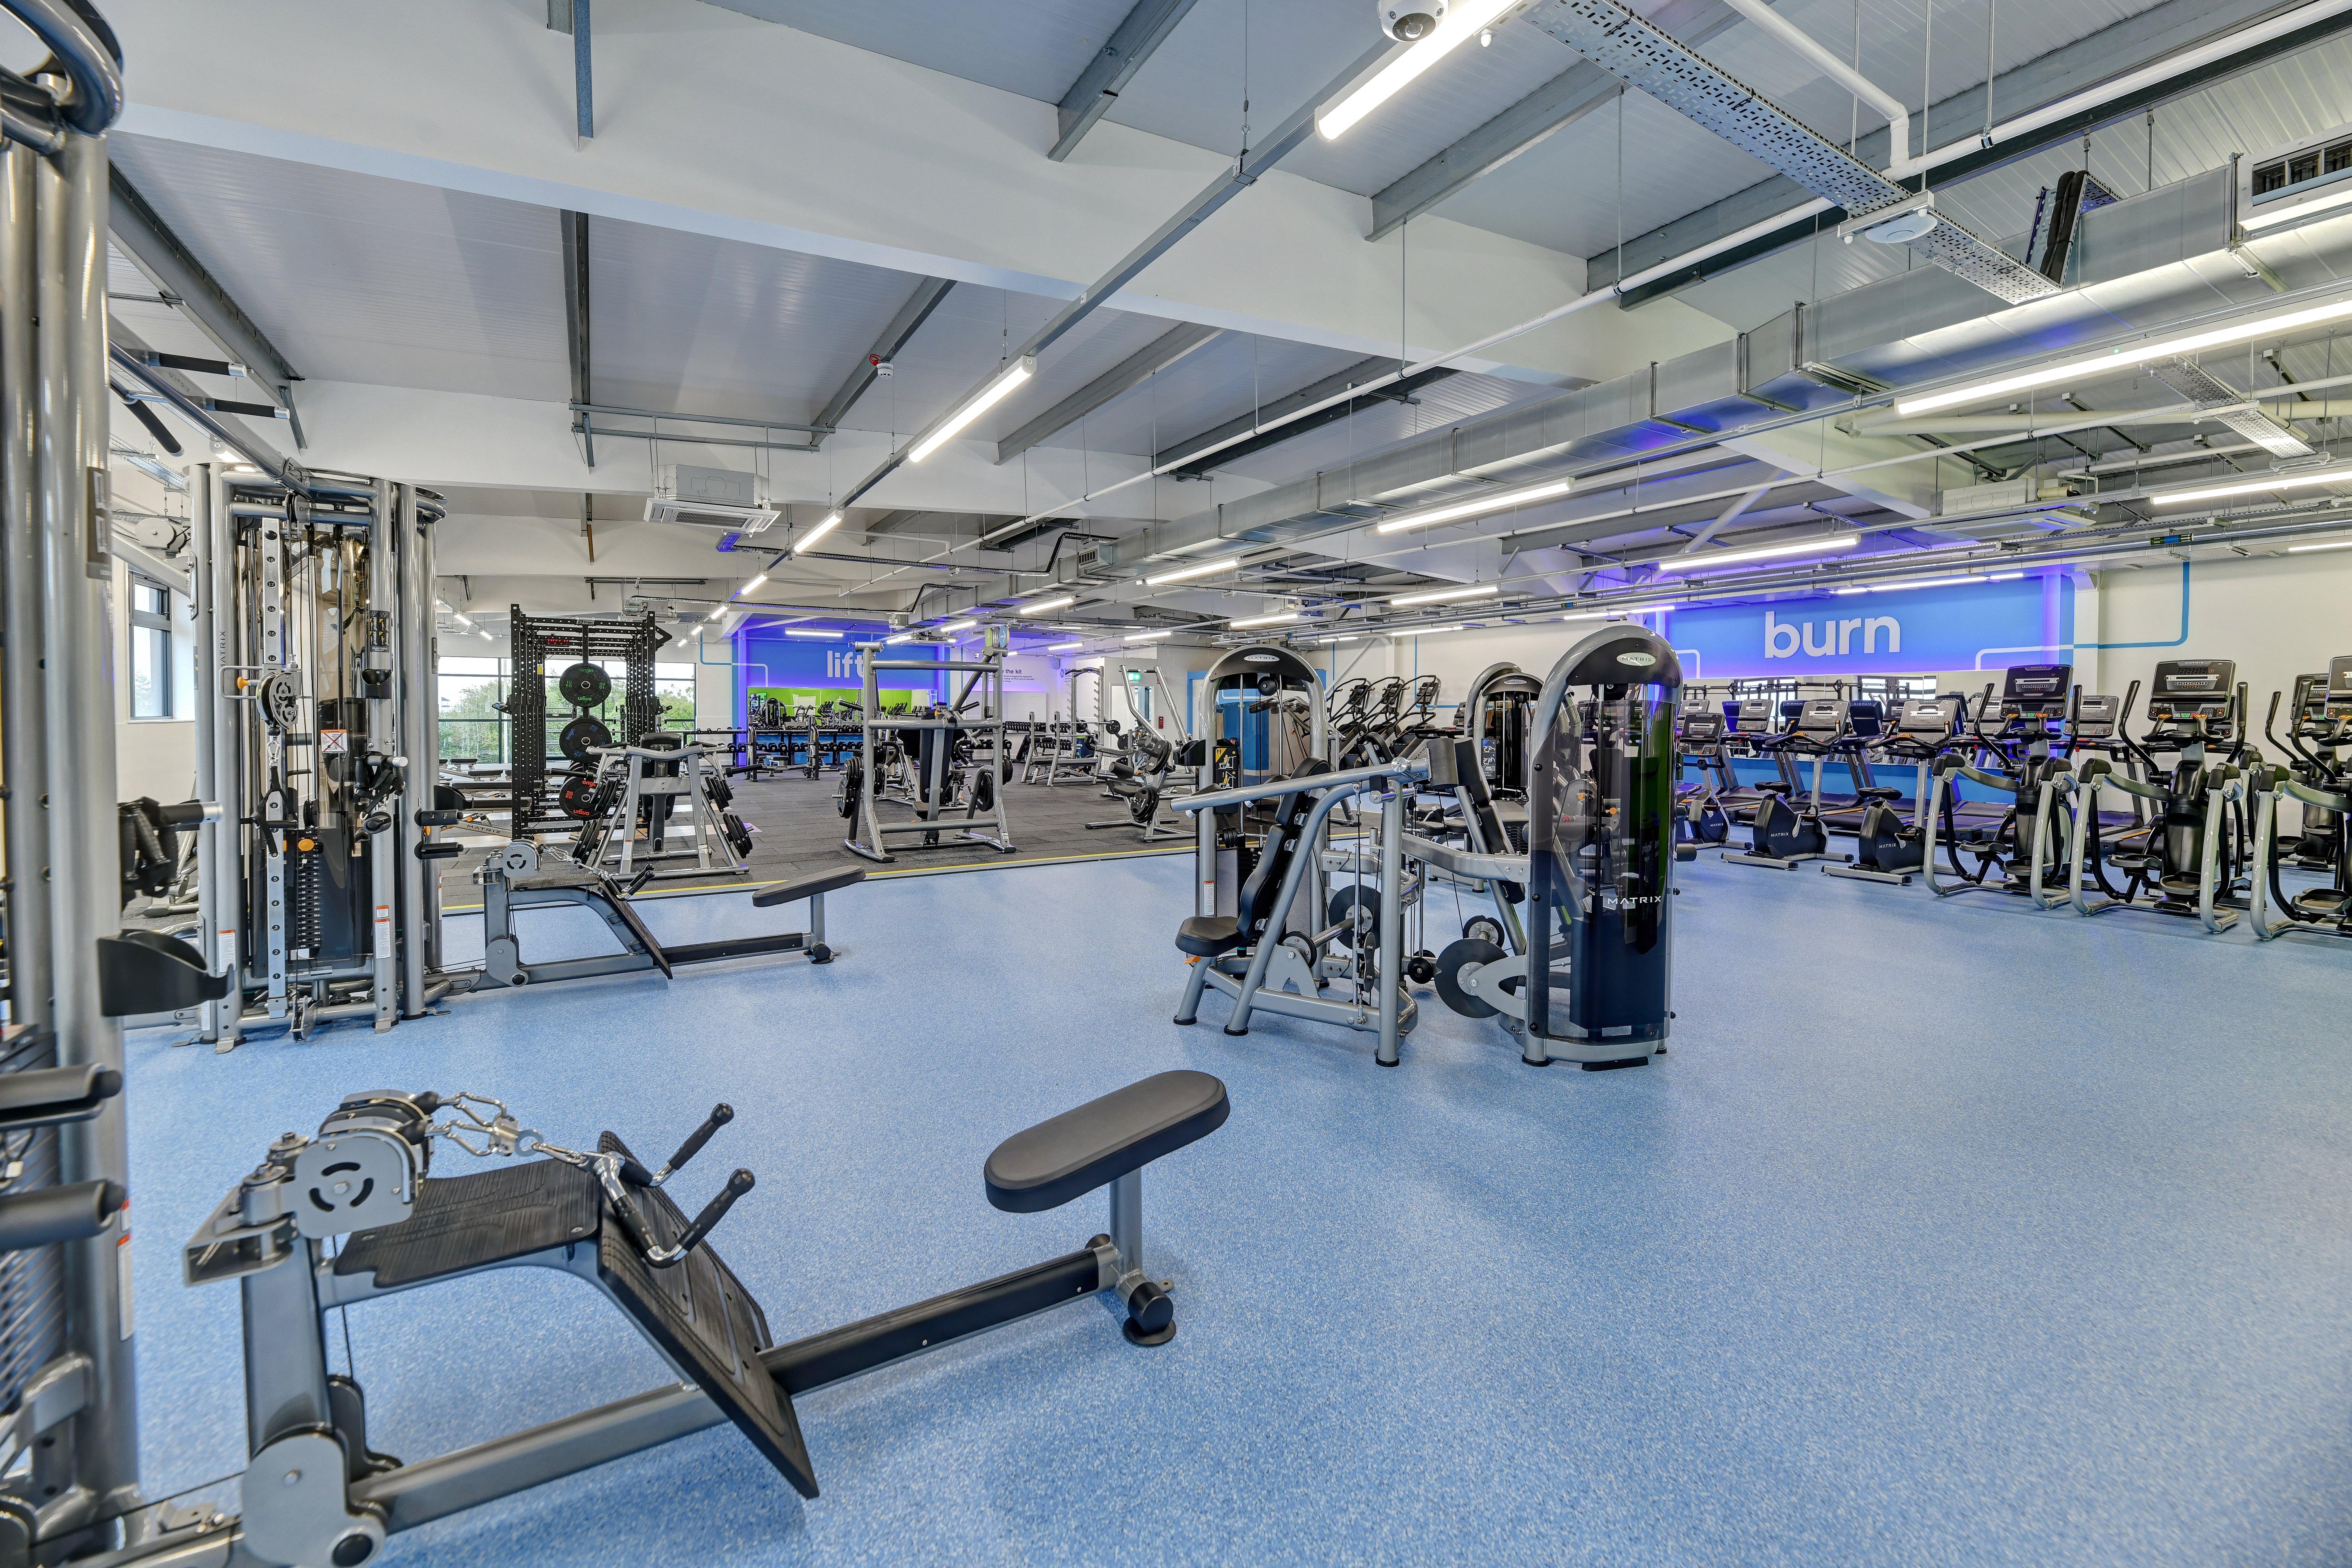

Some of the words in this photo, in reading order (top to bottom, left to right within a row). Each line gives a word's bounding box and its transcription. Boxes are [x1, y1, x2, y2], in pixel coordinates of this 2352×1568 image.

[1765, 611, 1900, 658] burn
[828, 650, 863, 678] lift
[566, 728, 575, 740] origin
[1414, 746, 1426, 760] MATRI
[467, 825, 501, 834] MATRIX
[1608, 896, 1661, 904] MATRIX
